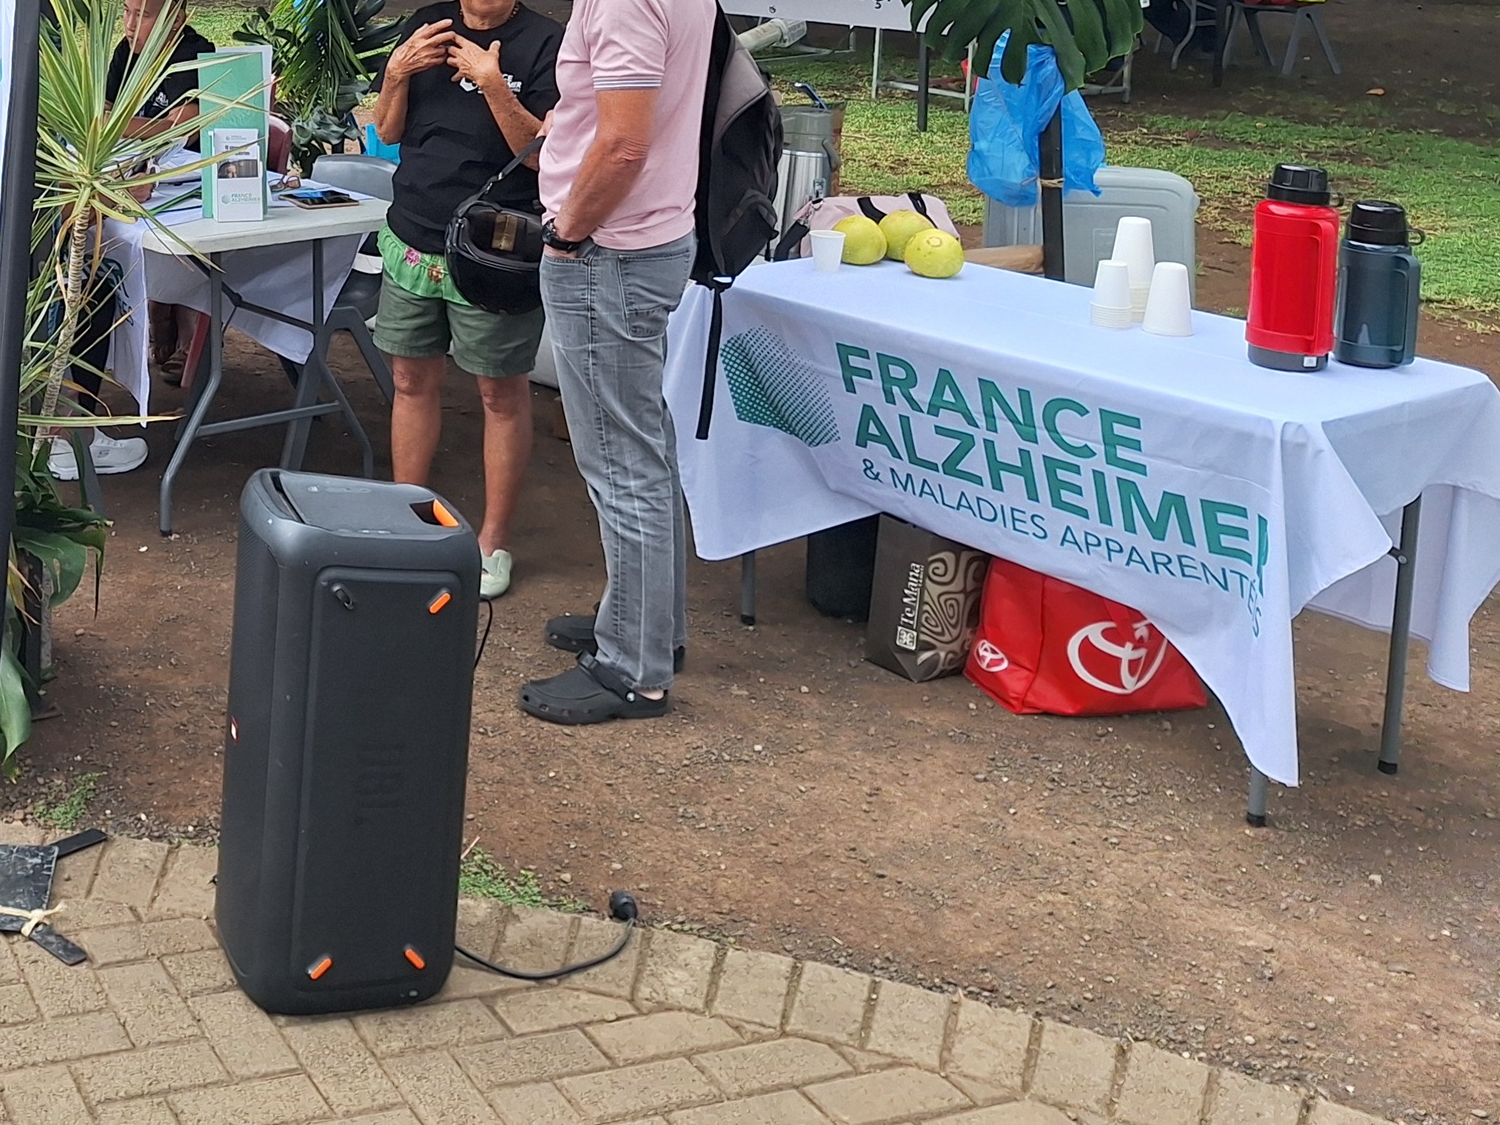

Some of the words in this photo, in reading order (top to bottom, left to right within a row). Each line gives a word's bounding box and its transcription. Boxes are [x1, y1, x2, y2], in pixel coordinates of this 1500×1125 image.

[836, 342, 1148, 477] FRANCE
[862, 458, 885, 484] &
[889, 467, 1049, 541] MALADIES
[900, 607, 916, 626] Te
[902, 562, 921, 607] Mana
